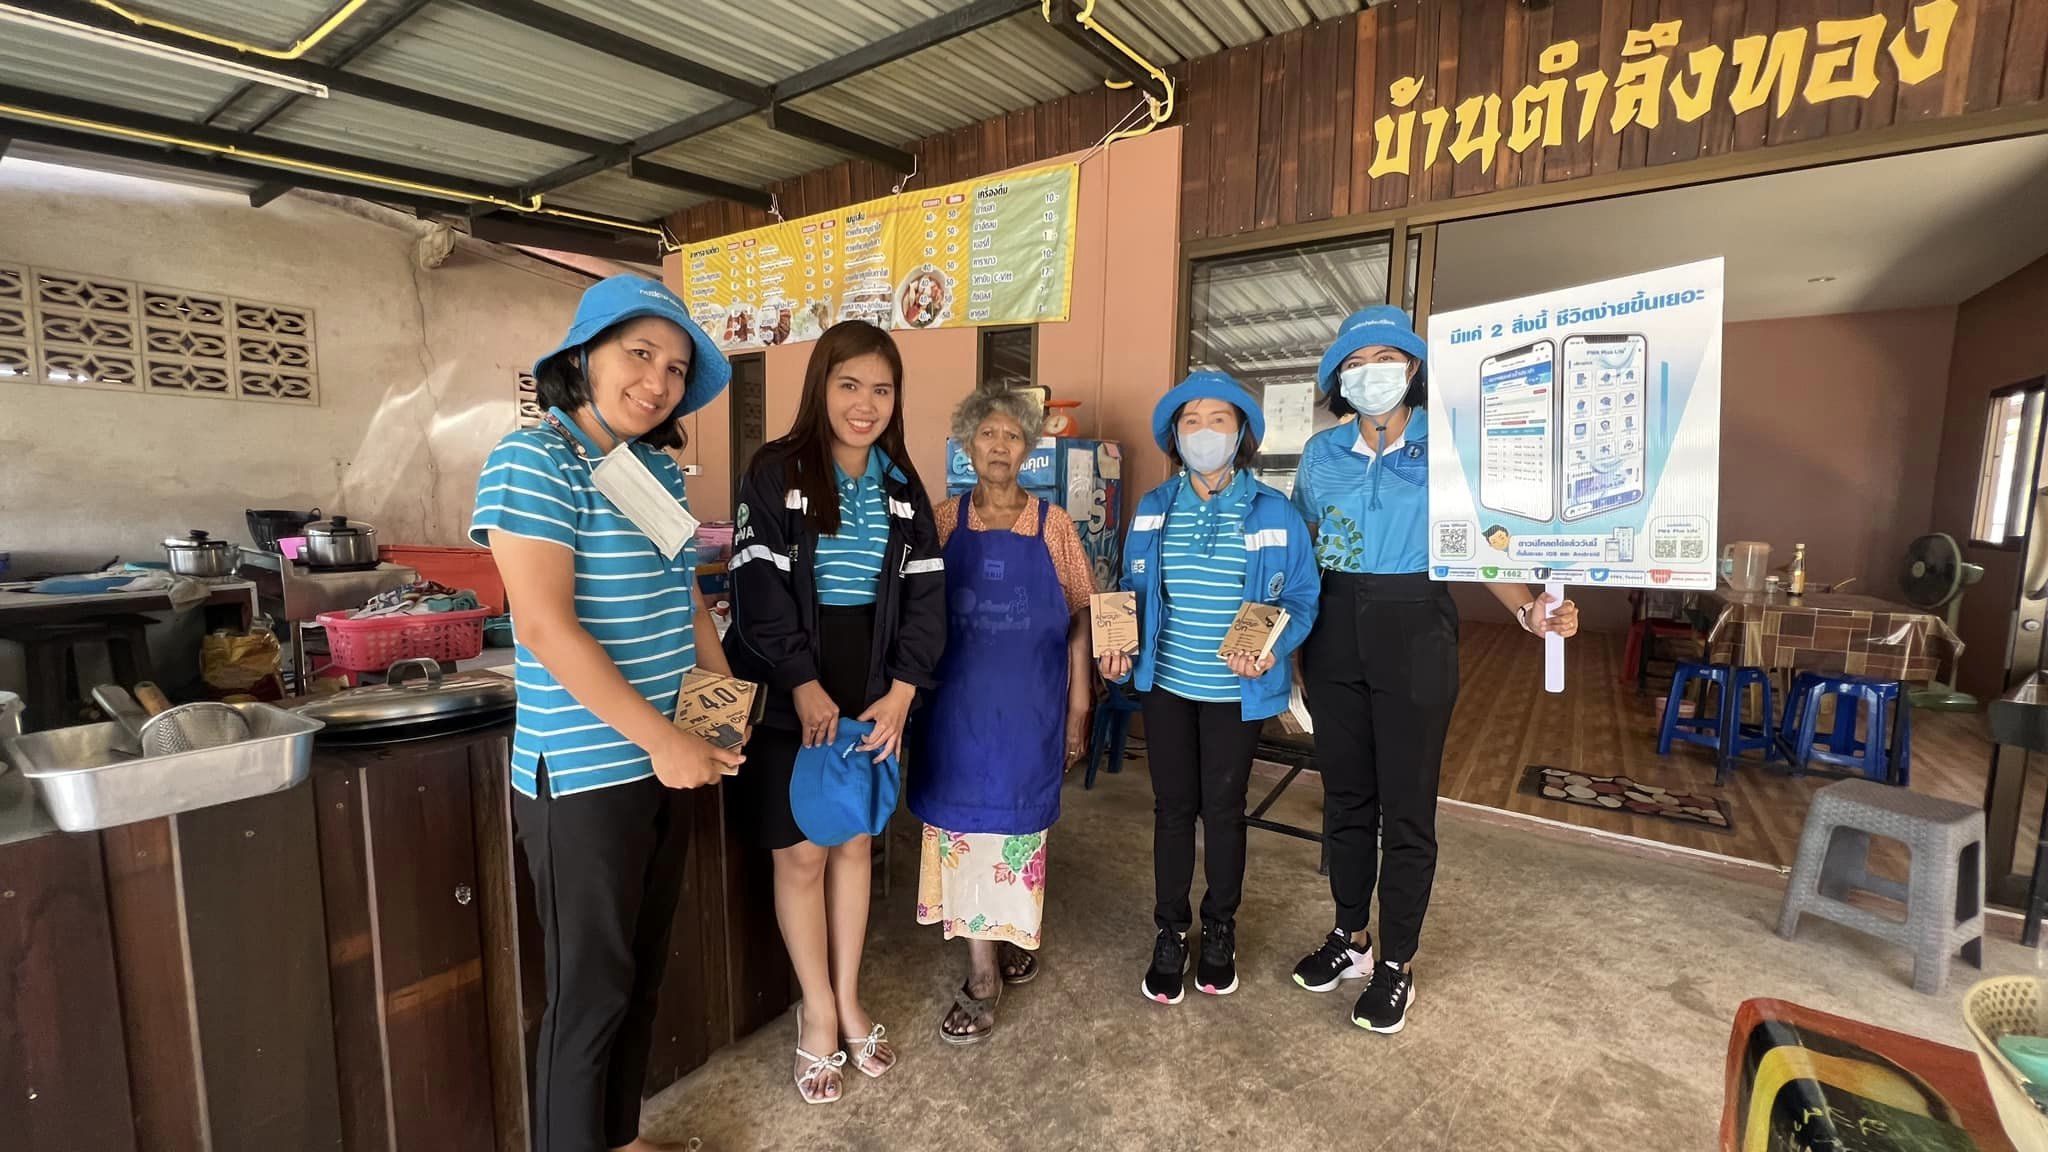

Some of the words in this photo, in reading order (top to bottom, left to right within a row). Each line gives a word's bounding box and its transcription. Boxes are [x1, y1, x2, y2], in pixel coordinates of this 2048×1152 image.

[1450, 325, 1482, 344] มีแค่
[1491, 324, 1503, 338] 2
[1512, 309, 1549, 334] สิ่งนี้
[1556, 289, 1705, 326] ชีวิตง่ายขึ้นเยอะ
[698, 687, 738, 710] 4.0
